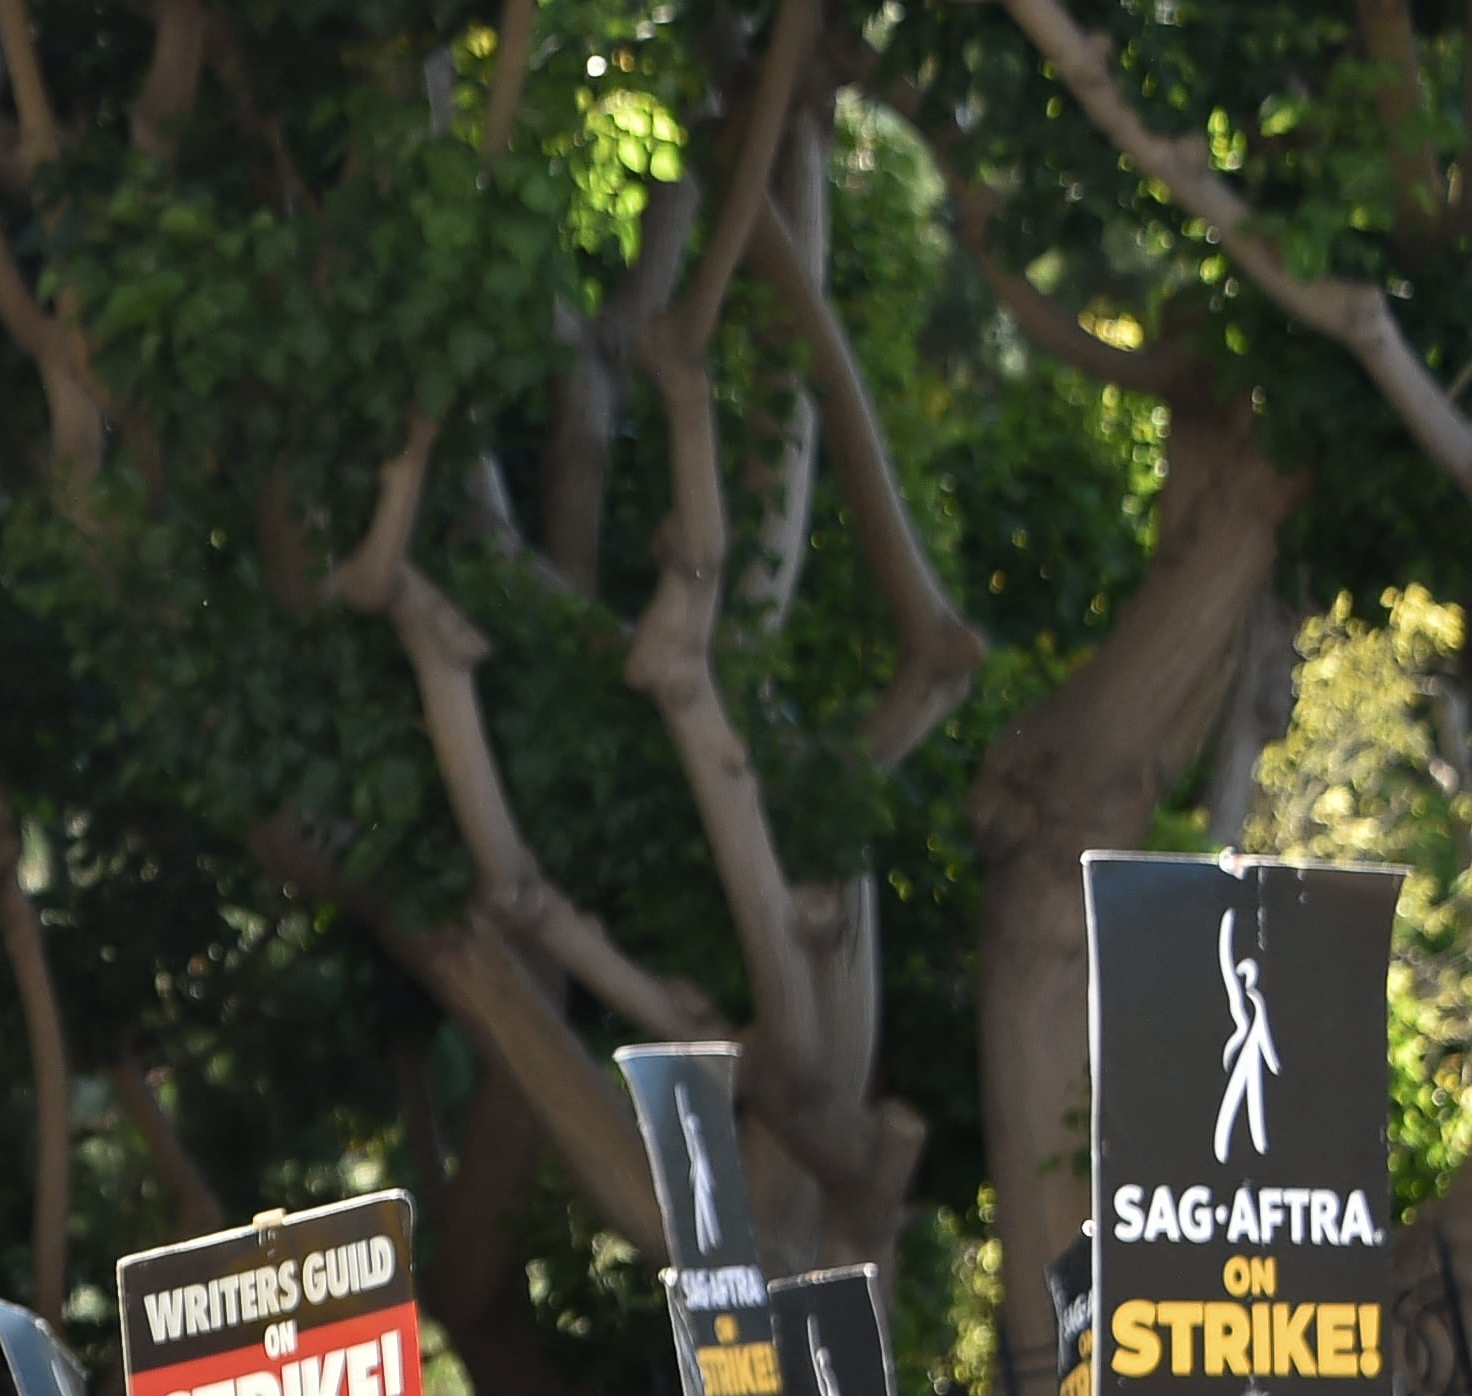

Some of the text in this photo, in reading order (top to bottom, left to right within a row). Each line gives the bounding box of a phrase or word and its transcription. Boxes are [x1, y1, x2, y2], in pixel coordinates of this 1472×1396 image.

[144, 1234, 396, 1344] WRITERS GUILD
[1223, 1255, 1276, 1298] ON
[264, 1320, 299, 1360] ON
[1110, 1299, 1382, 1379] STRIKE!
